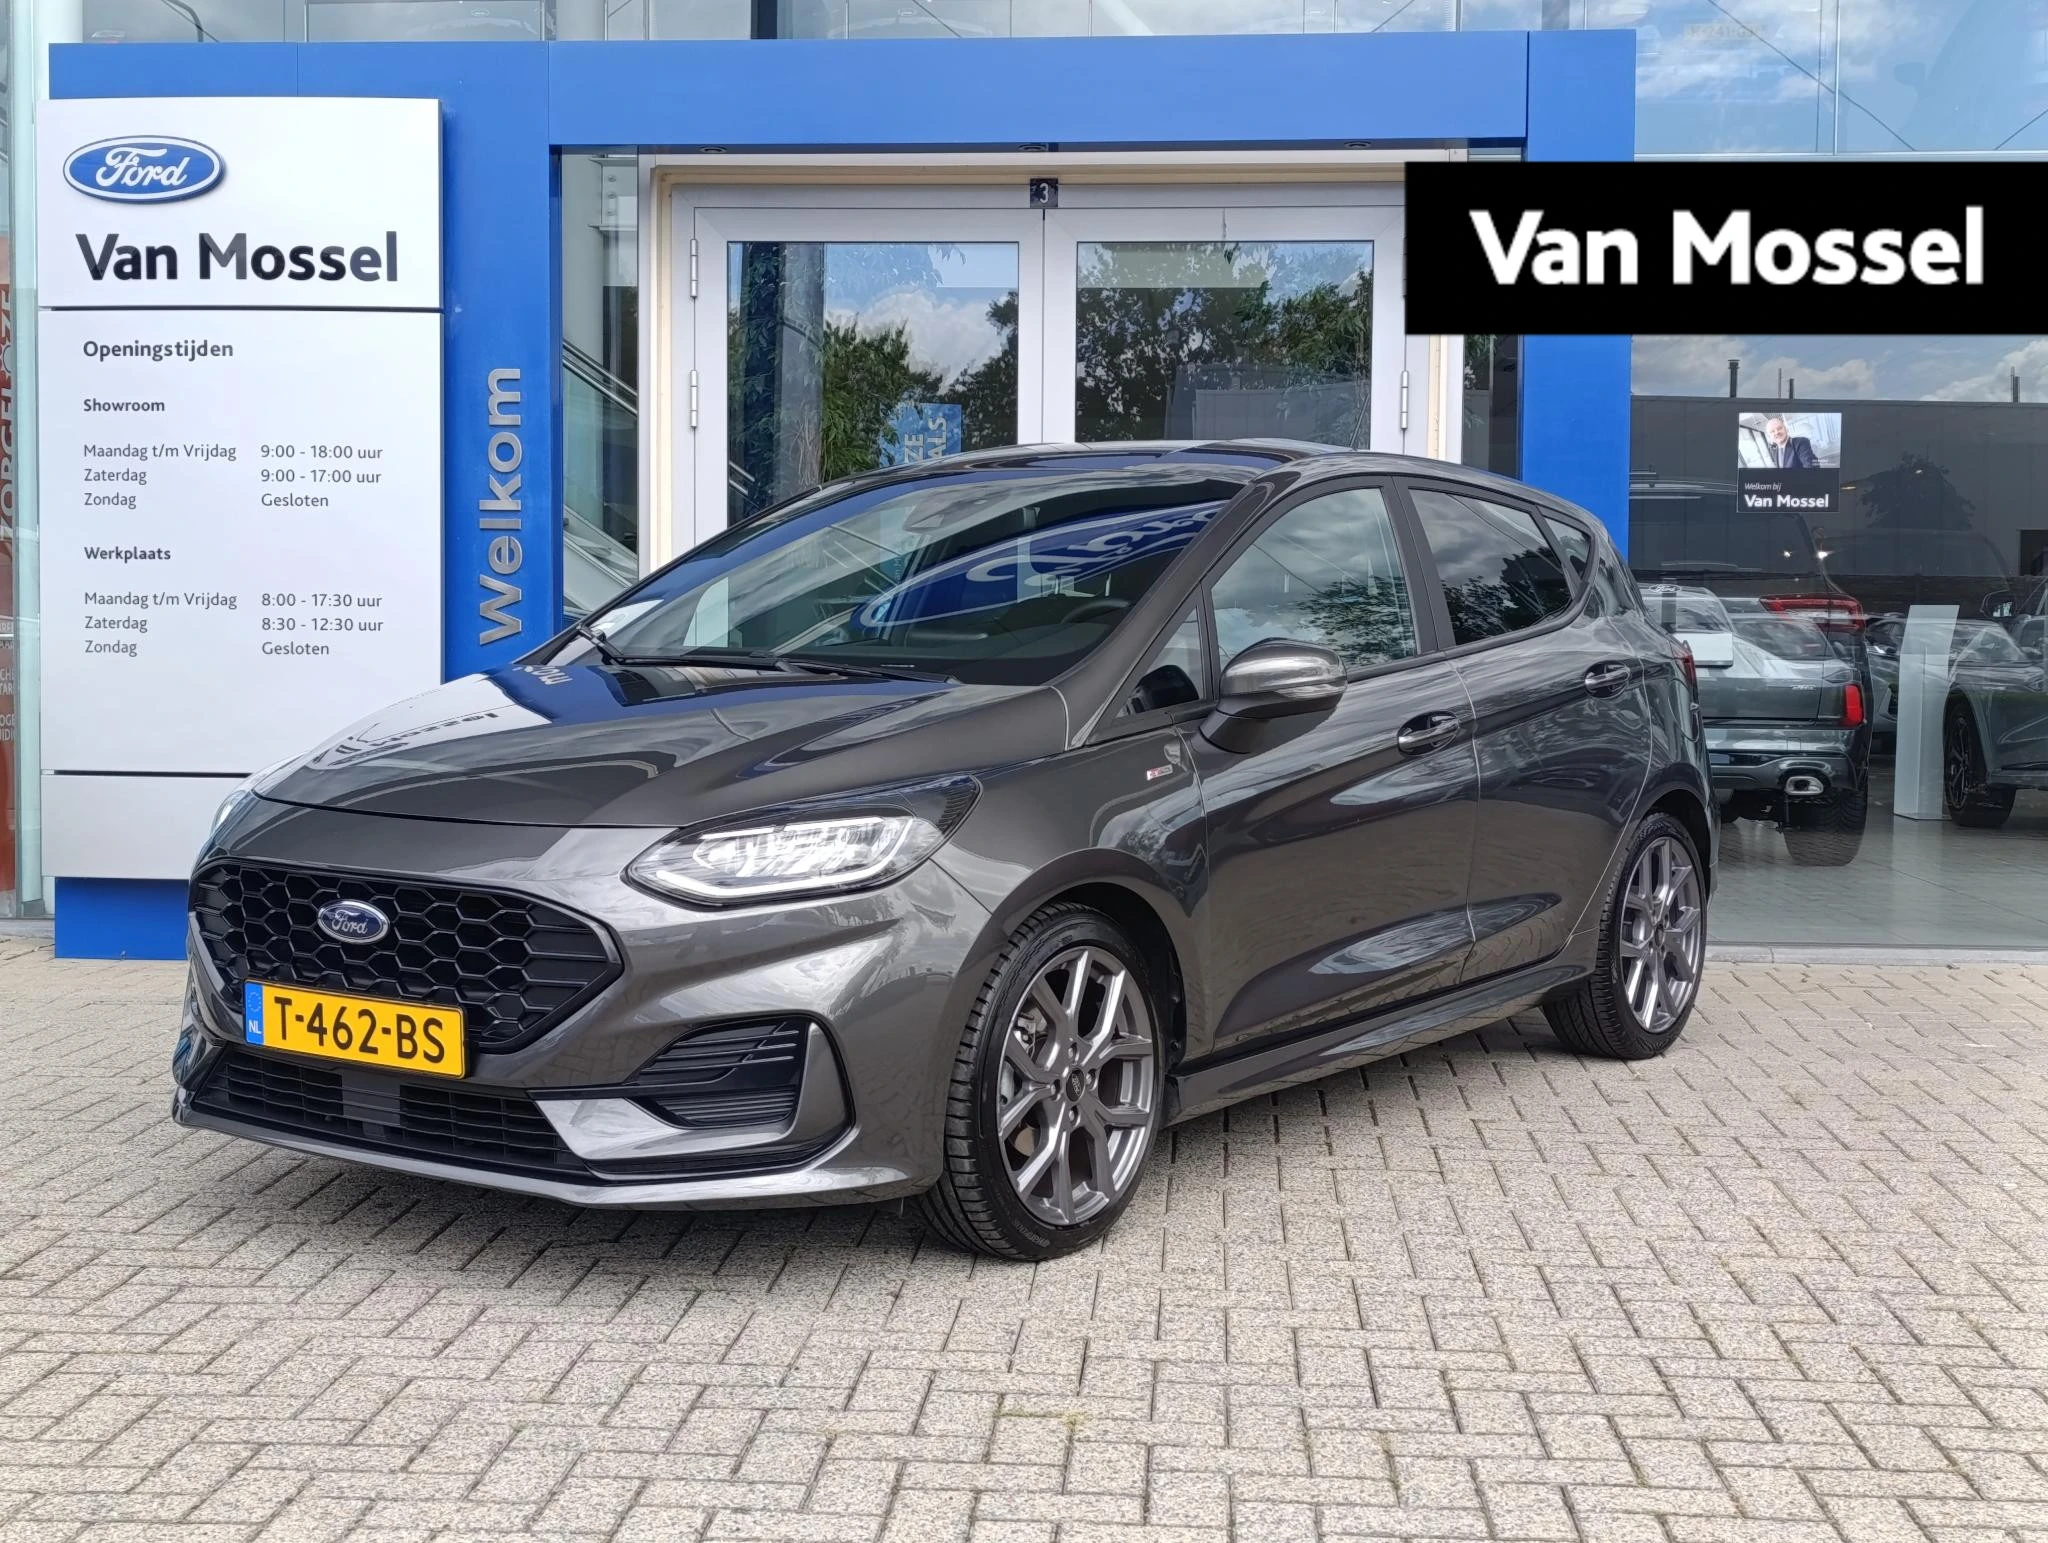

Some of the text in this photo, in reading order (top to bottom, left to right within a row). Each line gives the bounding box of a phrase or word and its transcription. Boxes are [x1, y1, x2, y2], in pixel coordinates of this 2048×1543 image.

[95, 146, 191, 187] Ford
[1039, 183, 1049, 204] 3
[75, 230, 398, 283] Van Mossel
[83, 339, 234, 362] Openingstijden
[83, 397, 166, 413] Showroom
[84, 443, 237, 462] Maandag t/m Vrijdag
[261, 444, 295, 458] 9:00
[311, 444, 353, 459] 18:00
[358, 448, 384, 459] uur
[84, 467, 148, 485] Zaterdag
[261, 468, 296, 483] 9:00
[311, 469, 352, 483] 17:00
[356, 473, 382, 484] uur
[84, 491, 137, 509] Zondag
[261, 492, 329, 507] Gesloten
[479, 367, 523, 646] Welkom
[1744, 493, 1829, 508] Van Mossel
[84, 545, 172, 565] Werkplaats
[85, 591, 238, 611] Maandag t/m Vrijdag
[262, 592, 297, 607] 8:00
[312, 593, 353, 607] 17:30
[357, 597, 383, 608] uur
[85, 615, 148, 634] Zaterdag
[262, 617, 296, 631] 8:30
[312, 617, 354, 632] 12:30
[358, 621, 384, 632] uur
[85, 639, 138, 658] Zondag
[262, 640, 330, 656] Gesloten
[331, 908, 369, 934] Ford
[248, 1020, 262, 1035] NL
[273, 996, 445, 1064] T-462-BS
